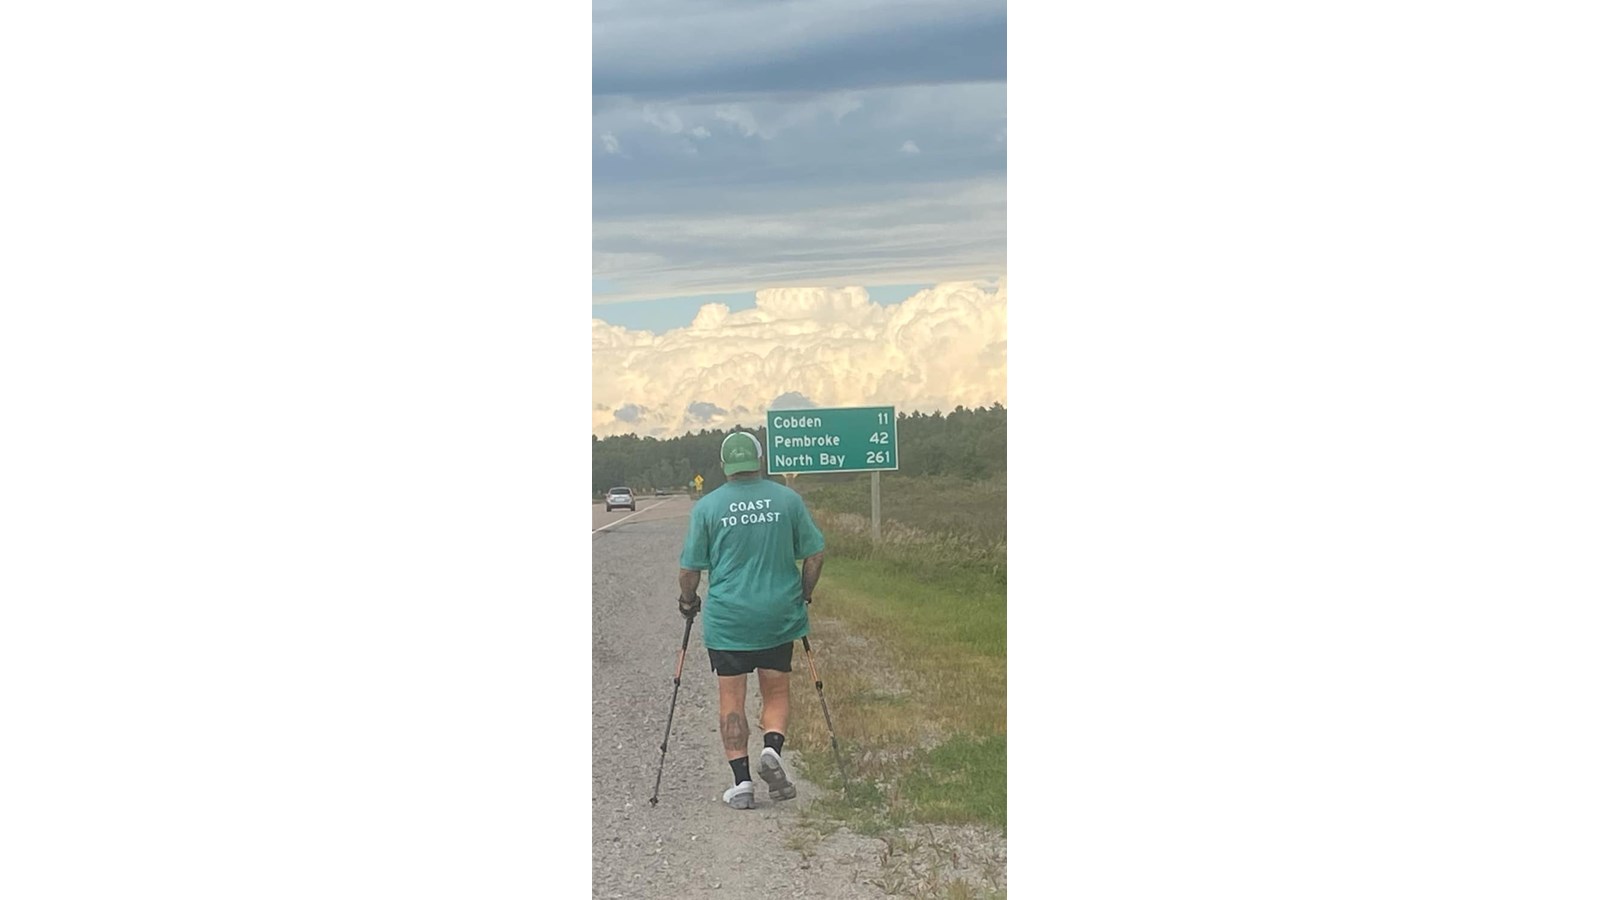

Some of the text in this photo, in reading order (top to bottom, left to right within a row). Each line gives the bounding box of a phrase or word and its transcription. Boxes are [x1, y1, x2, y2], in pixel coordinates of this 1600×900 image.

[773, 412, 889, 428] Cobden 11
[774, 432, 889, 448] Pembroke 42
[775, 451, 890, 467] North Bay 261
[729, 499, 772, 513] COAST
[721, 512, 781, 527] TO COAST
